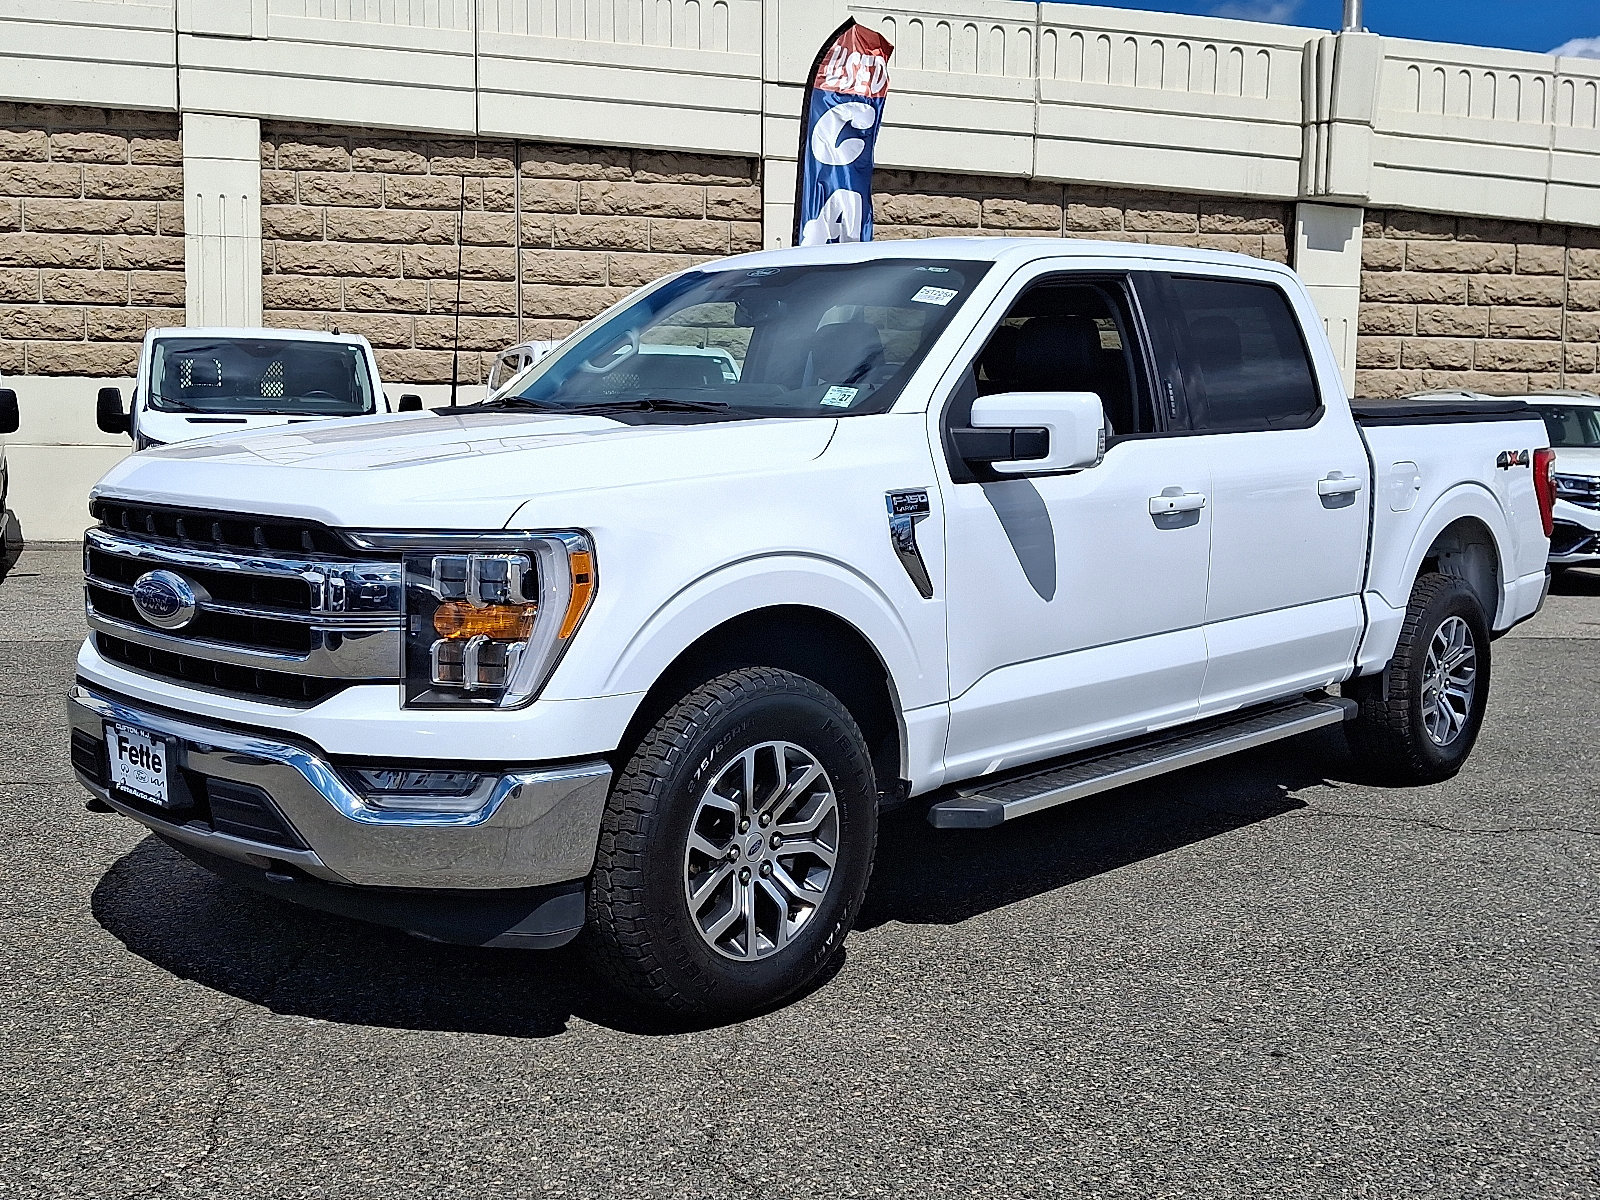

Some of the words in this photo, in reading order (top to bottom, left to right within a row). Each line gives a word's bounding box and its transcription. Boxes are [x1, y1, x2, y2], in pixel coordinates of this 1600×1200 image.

[825, 45, 888, 94] USED
[838, 393, 852, 402] 27
[892, 493, 928, 506] F-150
[896, 504, 919, 512] LARIAT
[117, 734, 163, 774] Fette
[115, 783, 163, 805] FetteAuto.com
